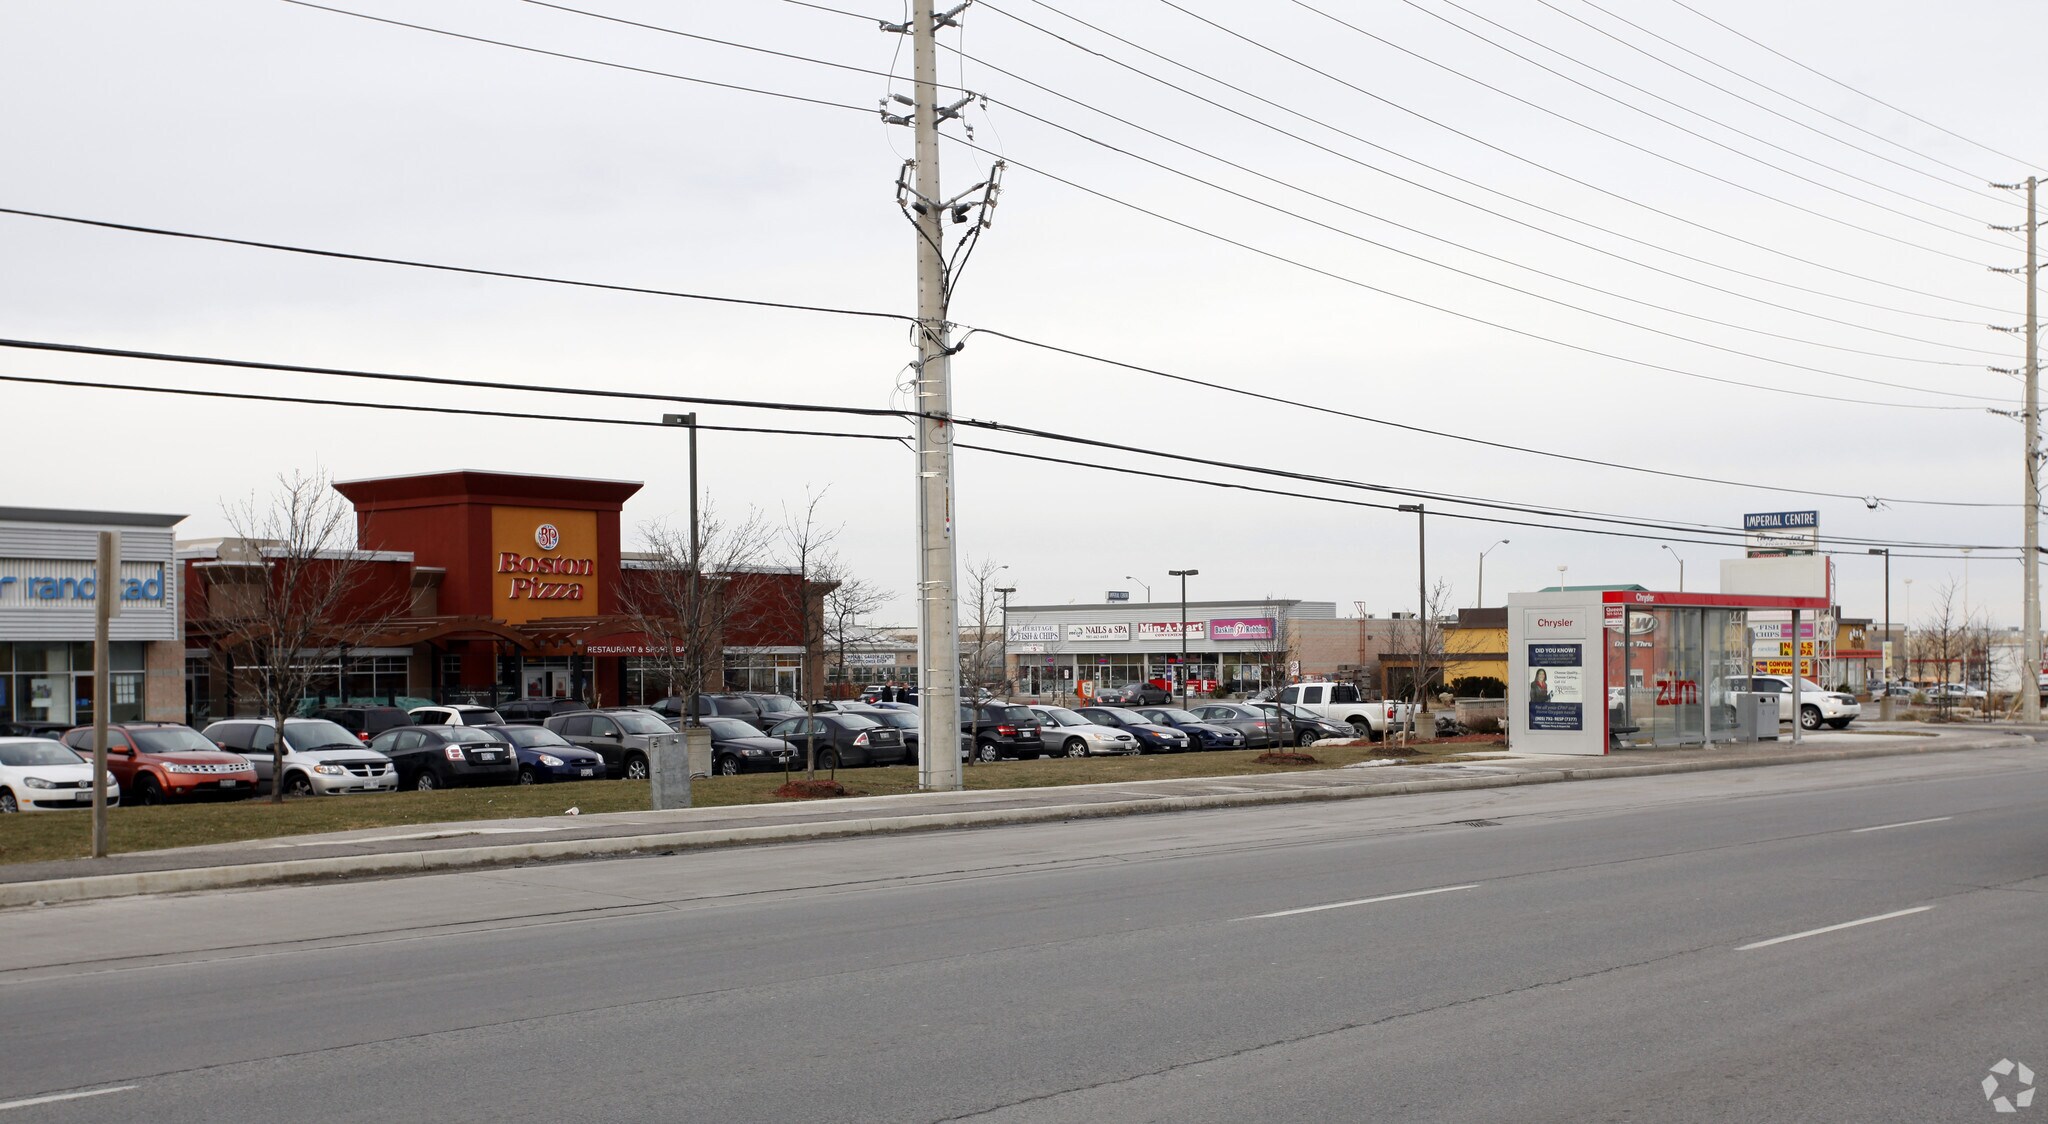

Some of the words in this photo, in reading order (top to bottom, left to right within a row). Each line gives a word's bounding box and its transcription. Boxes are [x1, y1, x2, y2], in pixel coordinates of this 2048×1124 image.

[1746, 514, 1782, 527] IMPERIAL
[1784, 512, 1814, 525] CENTRE
[540, 527, 557, 546] BP
[497, 552, 593, 576] Boston
[28, 568, 164, 600] randad
[509, 576, 584, 601] Pizza
[1636, 593, 1654, 603] Chrysler
[1085, 626, 1107, 634] NAILS
[1114, 626, 1127, 634] SPA
[1214, 626, 1234, 634] Baskin
[1537, 618, 1573, 628] Chrysler
[1039, 632, 1058, 640] CHIPS
[1656, 670, 1697, 706] züm
